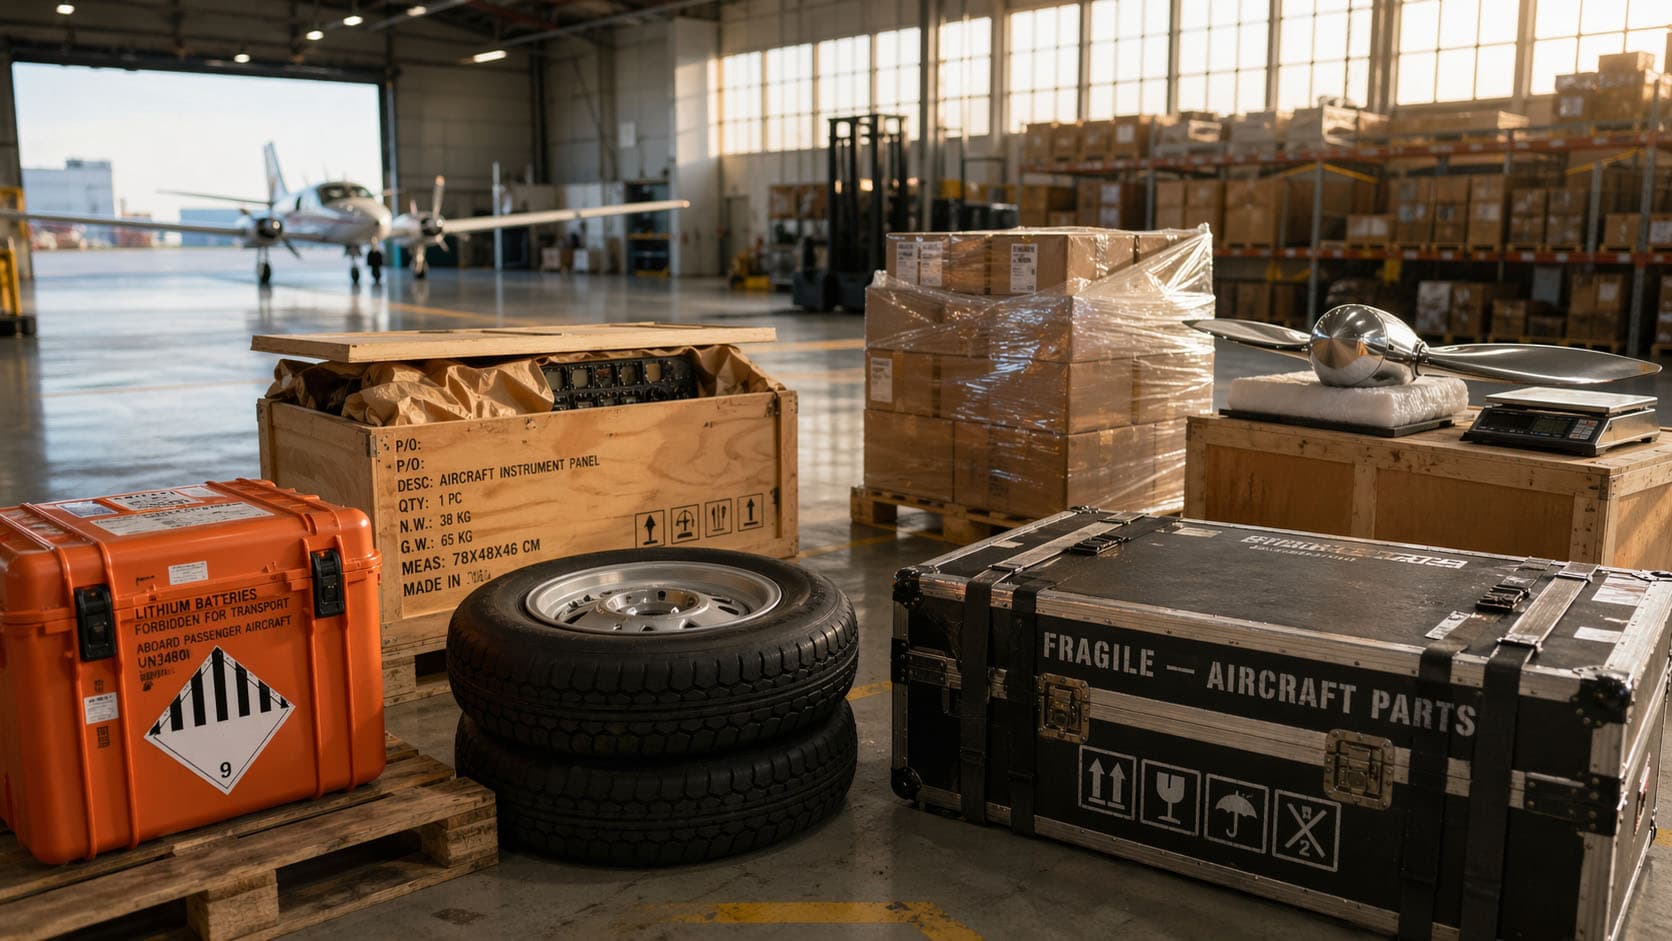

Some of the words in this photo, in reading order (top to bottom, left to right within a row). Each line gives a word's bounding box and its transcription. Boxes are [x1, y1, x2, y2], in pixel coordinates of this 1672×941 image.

[398, 477, 433, 492] DESC:
[440, 468, 495, 486] AIRCRAFT
[500, 459, 565, 478] INSTRUMENT
[570, 455, 600, 469] PANEL
[399, 498, 429, 513] QTY:
[440, 495, 445, 506] 1
[449, 492, 462, 504] PC
[400, 517, 433, 533] N.W.:
[440, 514, 453, 526] 38
[457, 511, 471, 523] KG
[401, 537, 434, 553] G.W.:
[441, 534, 454, 546] 65
[458, 530, 473, 544] KG
[402, 556, 446, 576] MEAS:
[453, 543, 518, 566] 78X48X46
[523, 539, 541, 553] CM
[403, 577, 442, 597] MADE
[448, 574, 461, 589] IN
[135, 599, 191, 620] LITHIUM
[135, 615, 201, 635] FORBIDDEN
[205, 610, 227, 623] FOR
[231, 598, 290, 617] TRANSPORT
[136, 637, 180, 654] ABOARD
[184, 627, 242, 645] PASSENGER
[245, 615, 293, 632] AIRCRAFT
[1043, 631, 1155, 678] FRAGILE
[1207, 661, 1357, 714] AIRCRAFT
[1371, 689, 1477, 738] PARTS
[220, 761, 232, 778] 9
